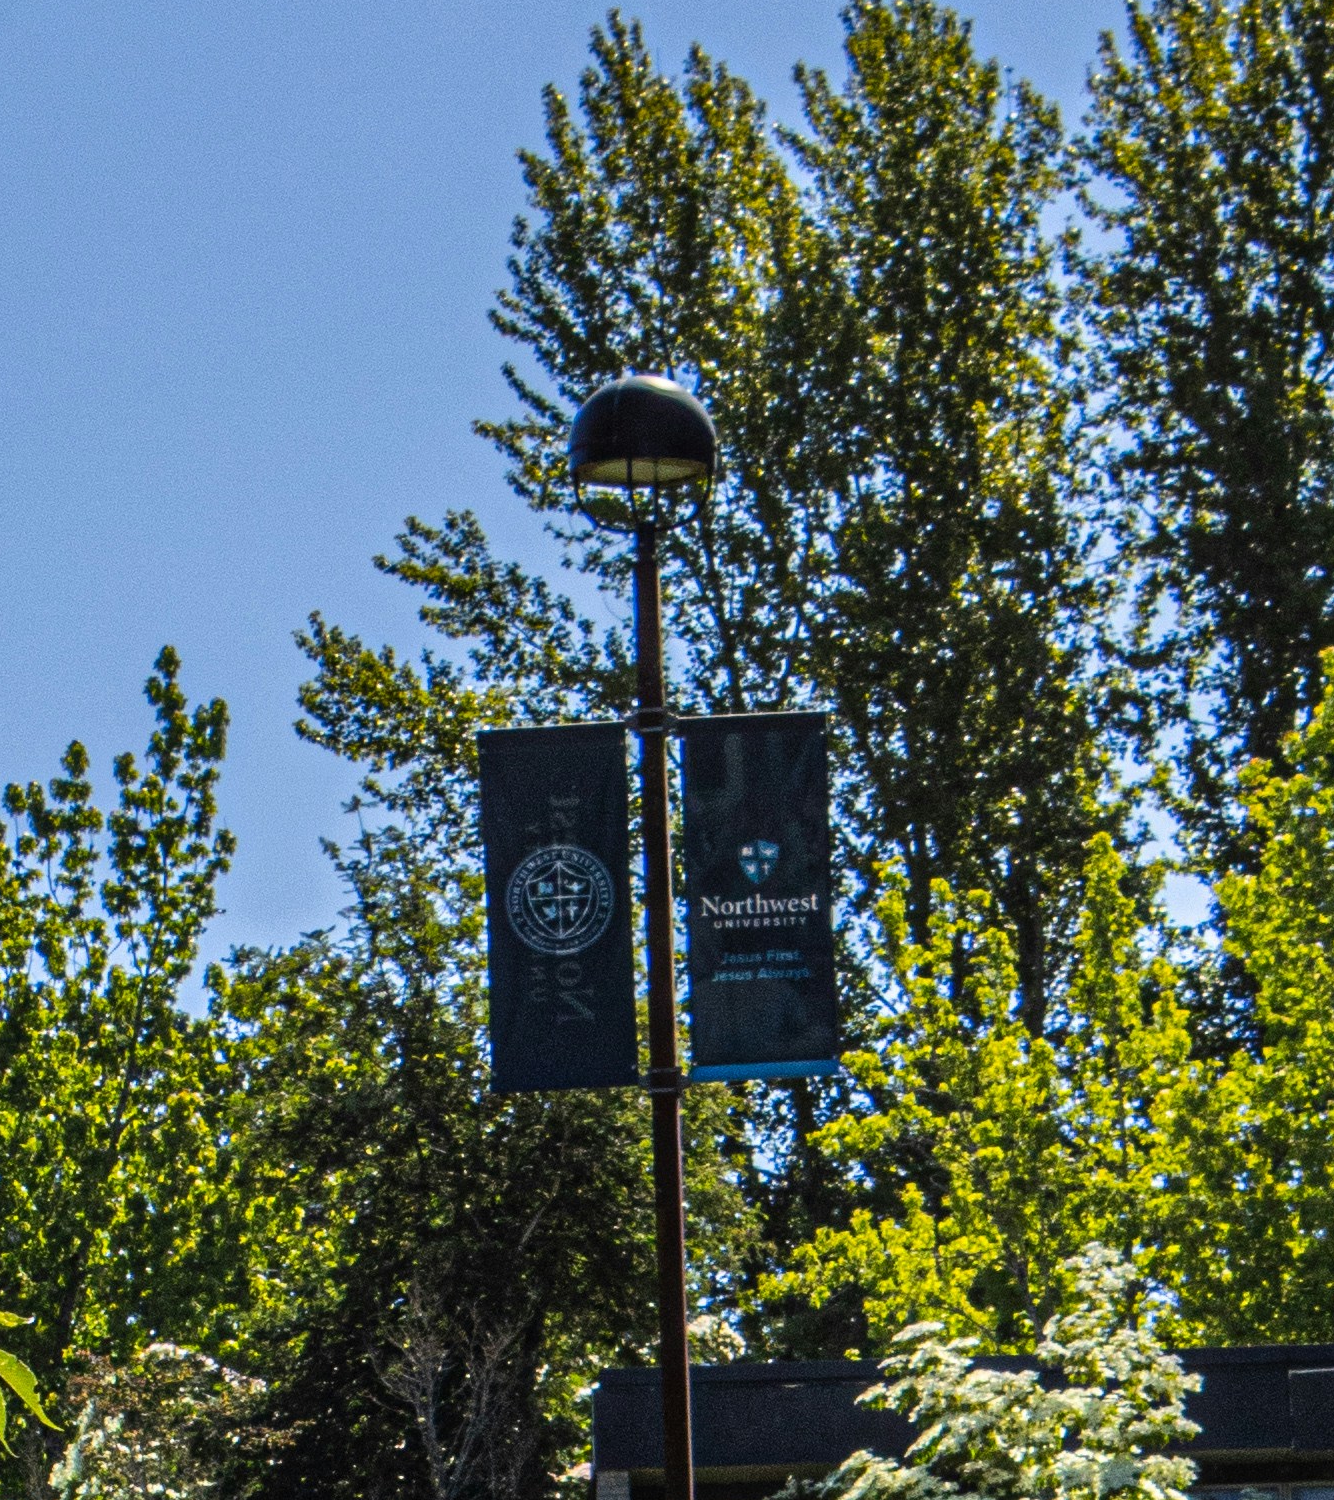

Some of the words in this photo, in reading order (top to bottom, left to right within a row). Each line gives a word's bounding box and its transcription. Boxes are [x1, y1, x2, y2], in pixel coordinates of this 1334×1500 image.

[700, 893, 819, 916] Northwest
[713, 916, 807, 929] UNIVERSITY
[721, 952, 763, 965] Jesus
[712, 970, 753, 982] Jesus
